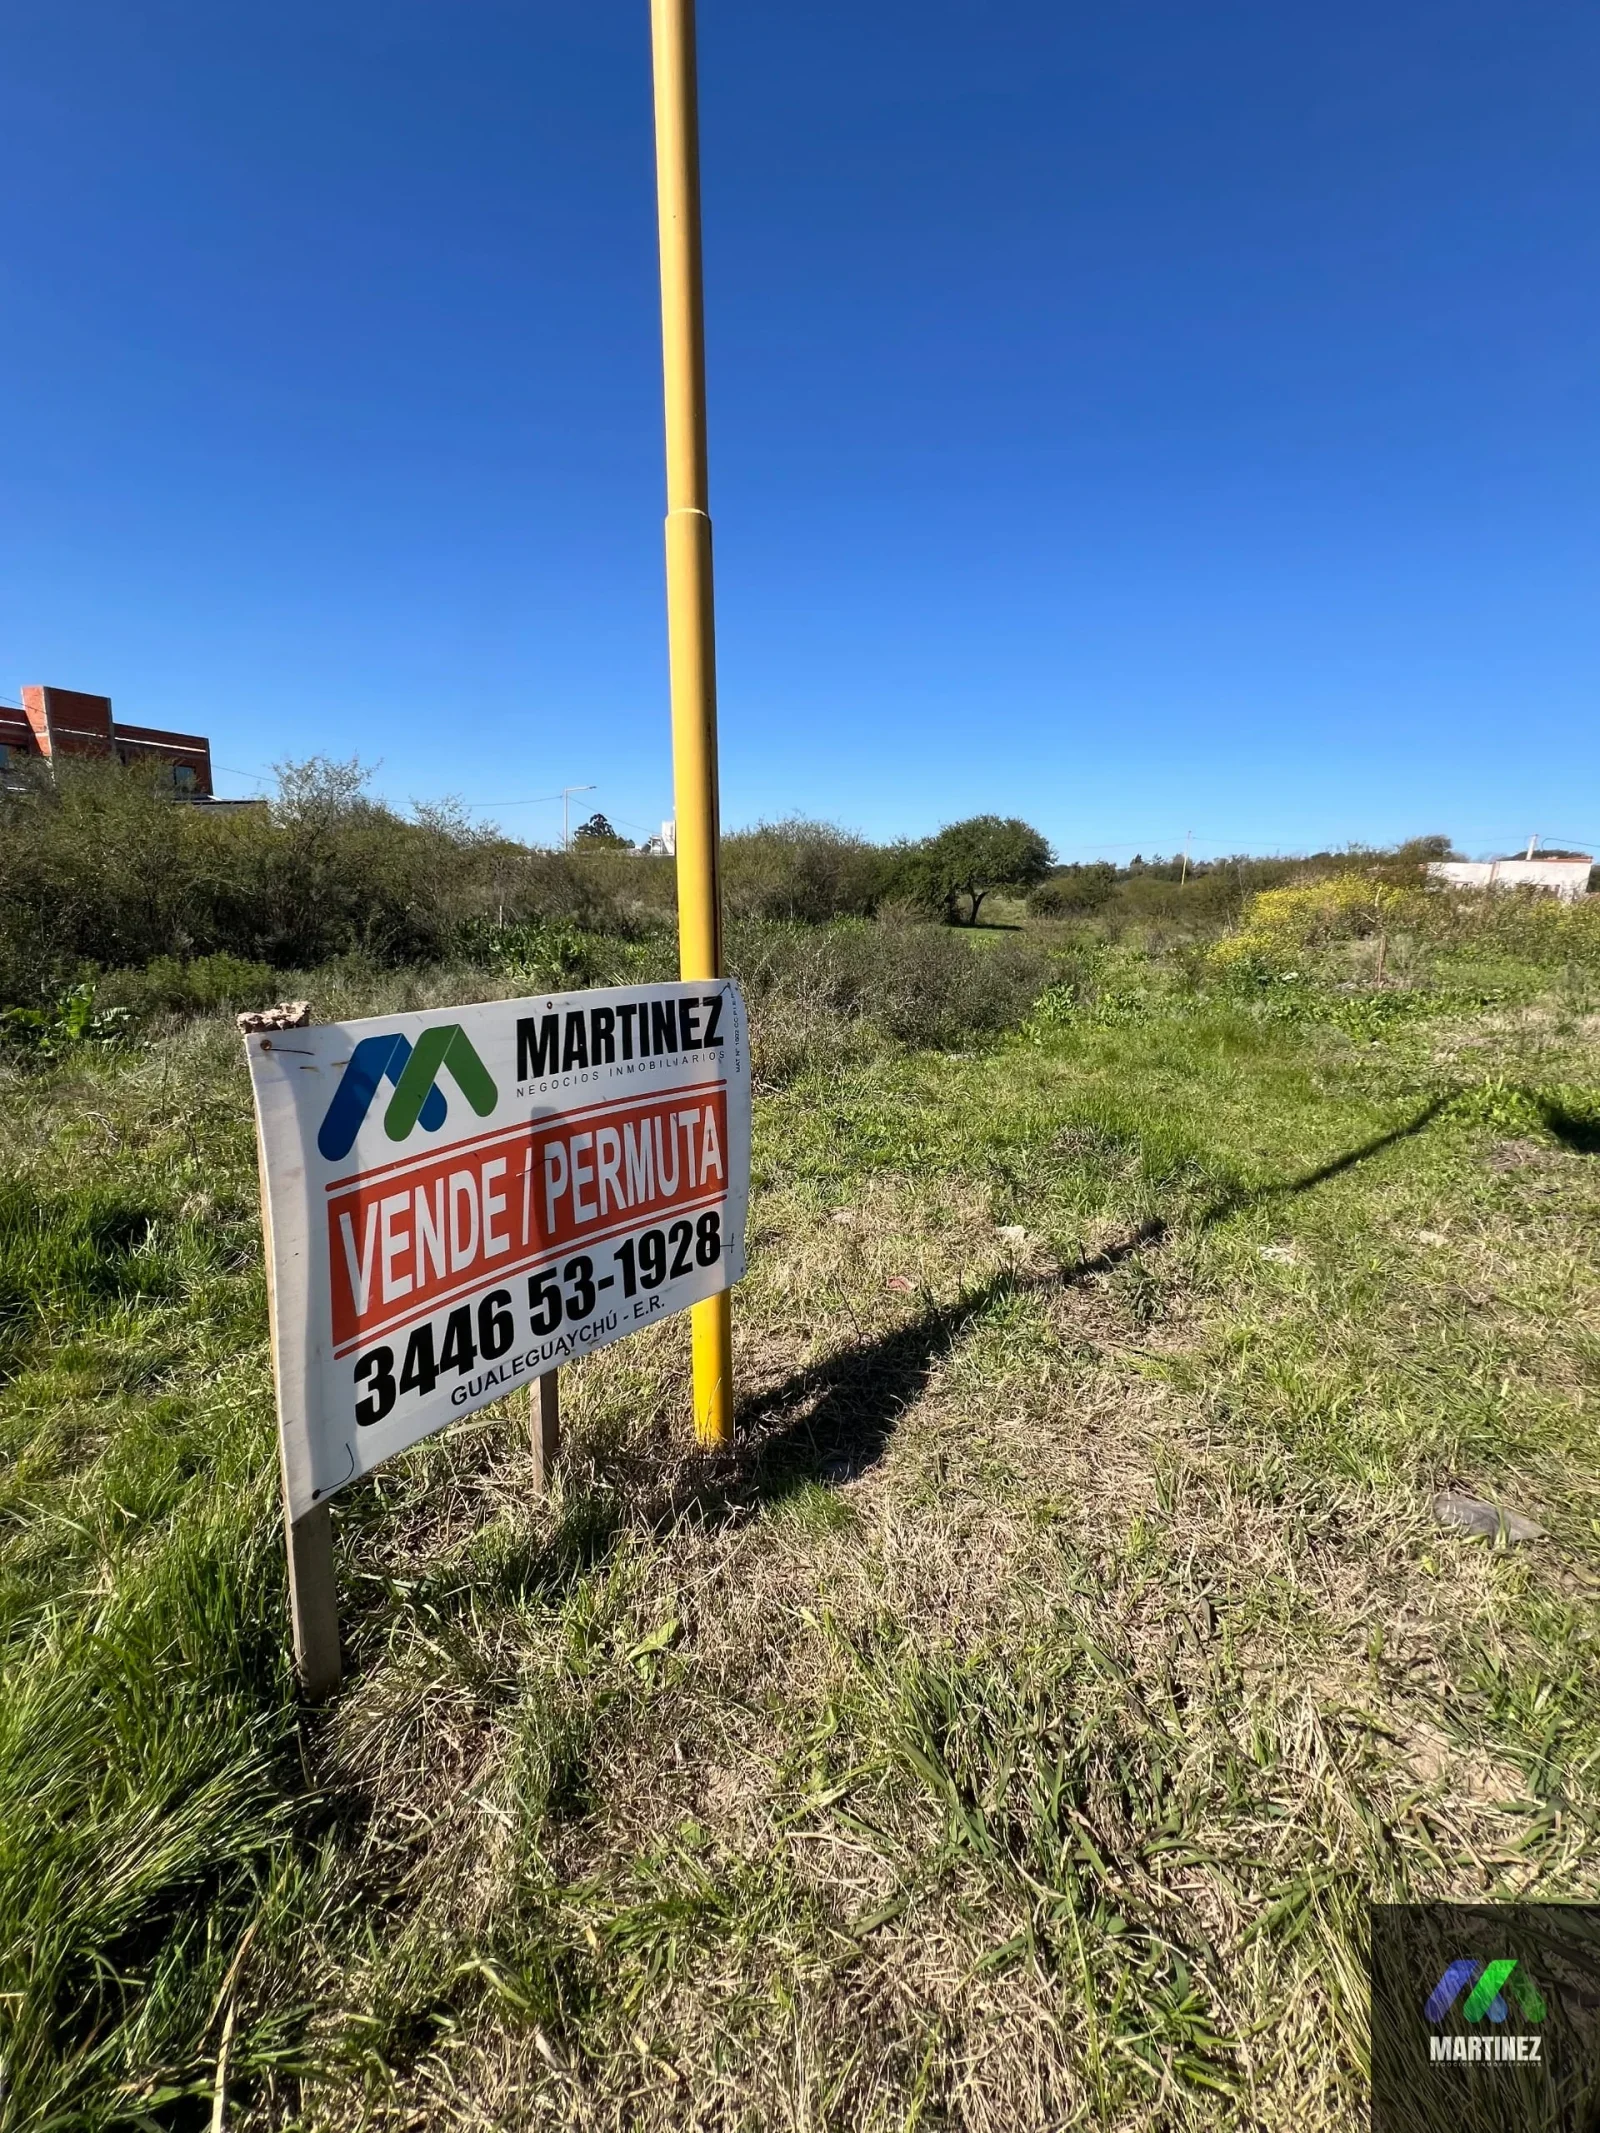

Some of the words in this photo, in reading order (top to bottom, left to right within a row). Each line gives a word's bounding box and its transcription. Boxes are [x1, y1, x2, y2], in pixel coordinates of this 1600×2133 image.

[516, 1071, 599, 1098] NEGOCIOS
[609, 1050, 725, 1077] INMOBILIARIOS
[517, 995, 724, 1082] MARTINEZ
[339, 1157, 511, 1317] VENDE
[544, 1104, 724, 1235] PERMUTA
[353, 1288, 515, 1428] 3446
[527, 1210, 722, 1337] 53-1928
[451, 1309, 618, 1406] GUALEGUAYCHÚ
[633, 1295, 666, 1320] E.R.
